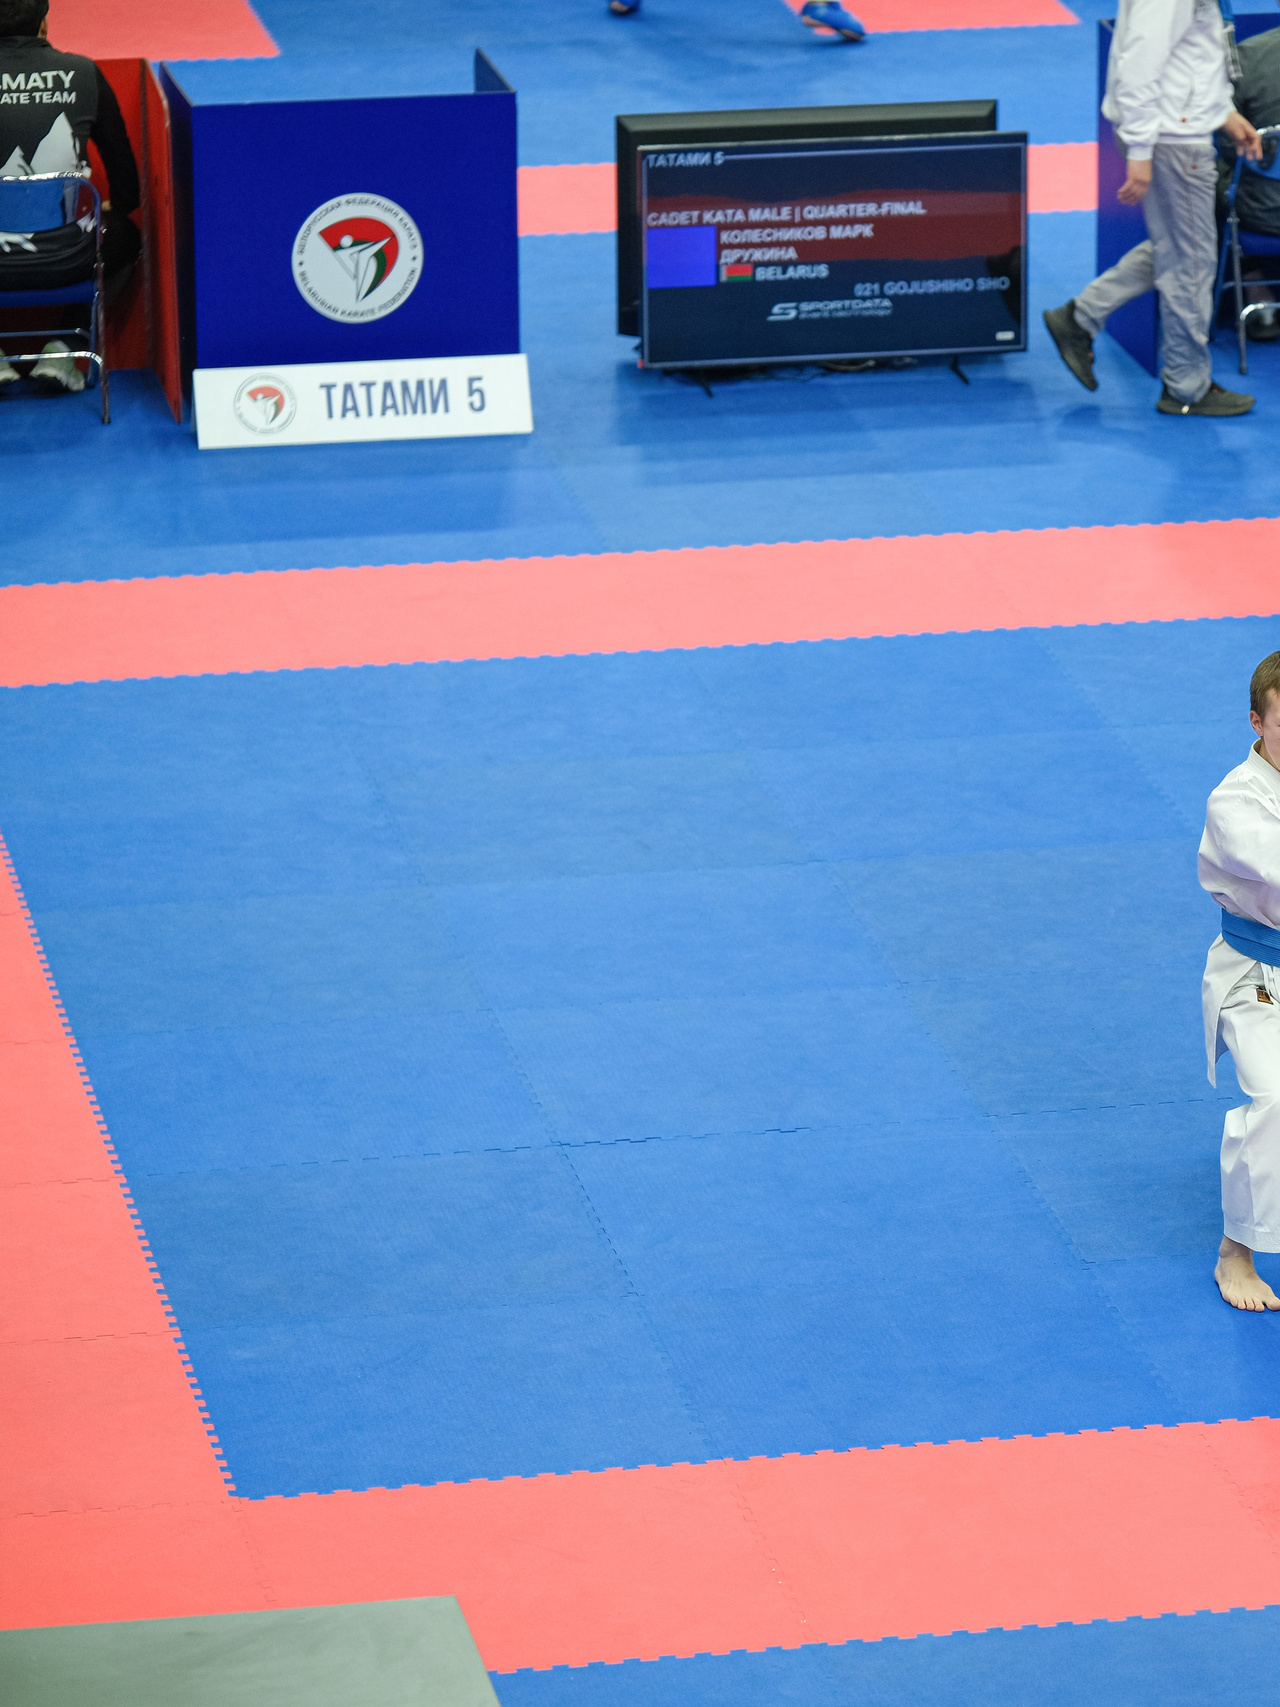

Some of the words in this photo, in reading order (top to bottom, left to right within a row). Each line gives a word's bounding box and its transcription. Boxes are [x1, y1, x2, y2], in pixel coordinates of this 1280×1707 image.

[0, 70, 75, 91] MATY
[32, 91, 76, 104] TEAM
[648, 153, 712, 168] ТАТАМИ
[647, 210, 700, 226] CADET
[702, 208, 747, 224] KATA
[748, 206, 792, 222] MALE
[802, 200, 927, 219] QUARTER-FINAL
[719, 225, 827, 244] КОЛЕСНИКОВ
[829, 223, 874, 239] МАРК
[719, 246, 798, 265] ДРУЖИНА
[755, 263, 829, 281] BELARUS
[854, 282, 881, 297] 021
[883, 277, 975, 296] GOJUSHIHO
[976, 276, 1011, 291] SHO
[798, 298, 894, 311] SPORTDATA
[319, 377, 450, 419] ТАТАМИ
[466, 375, 487, 413] 5
